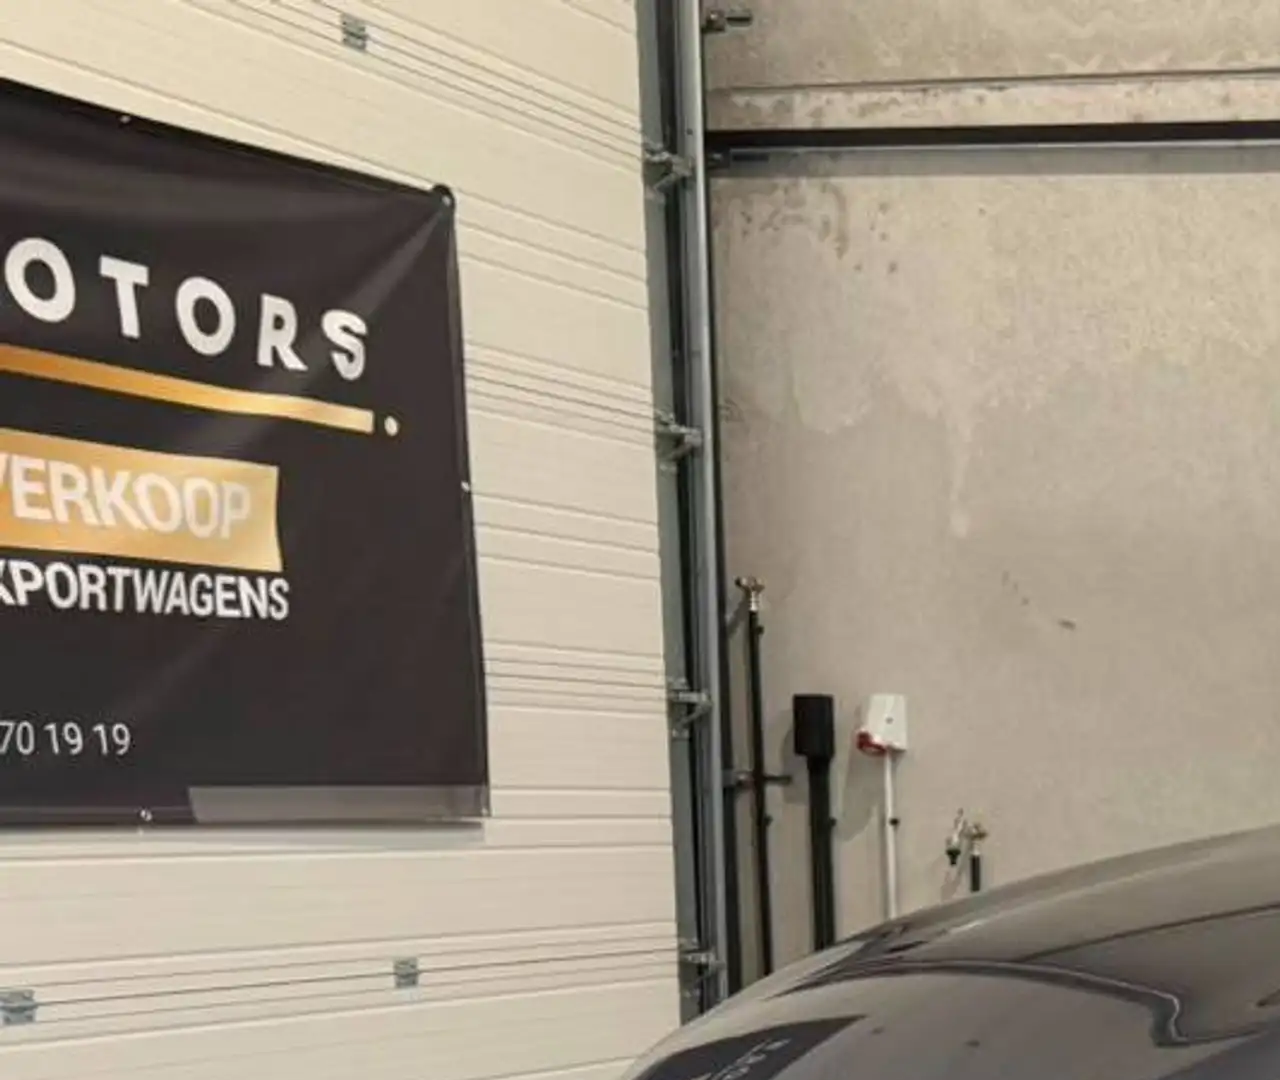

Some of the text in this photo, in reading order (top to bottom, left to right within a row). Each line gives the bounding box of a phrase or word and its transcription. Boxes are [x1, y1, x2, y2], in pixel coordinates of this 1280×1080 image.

[0, 720, 131, 755] 70 19 19
